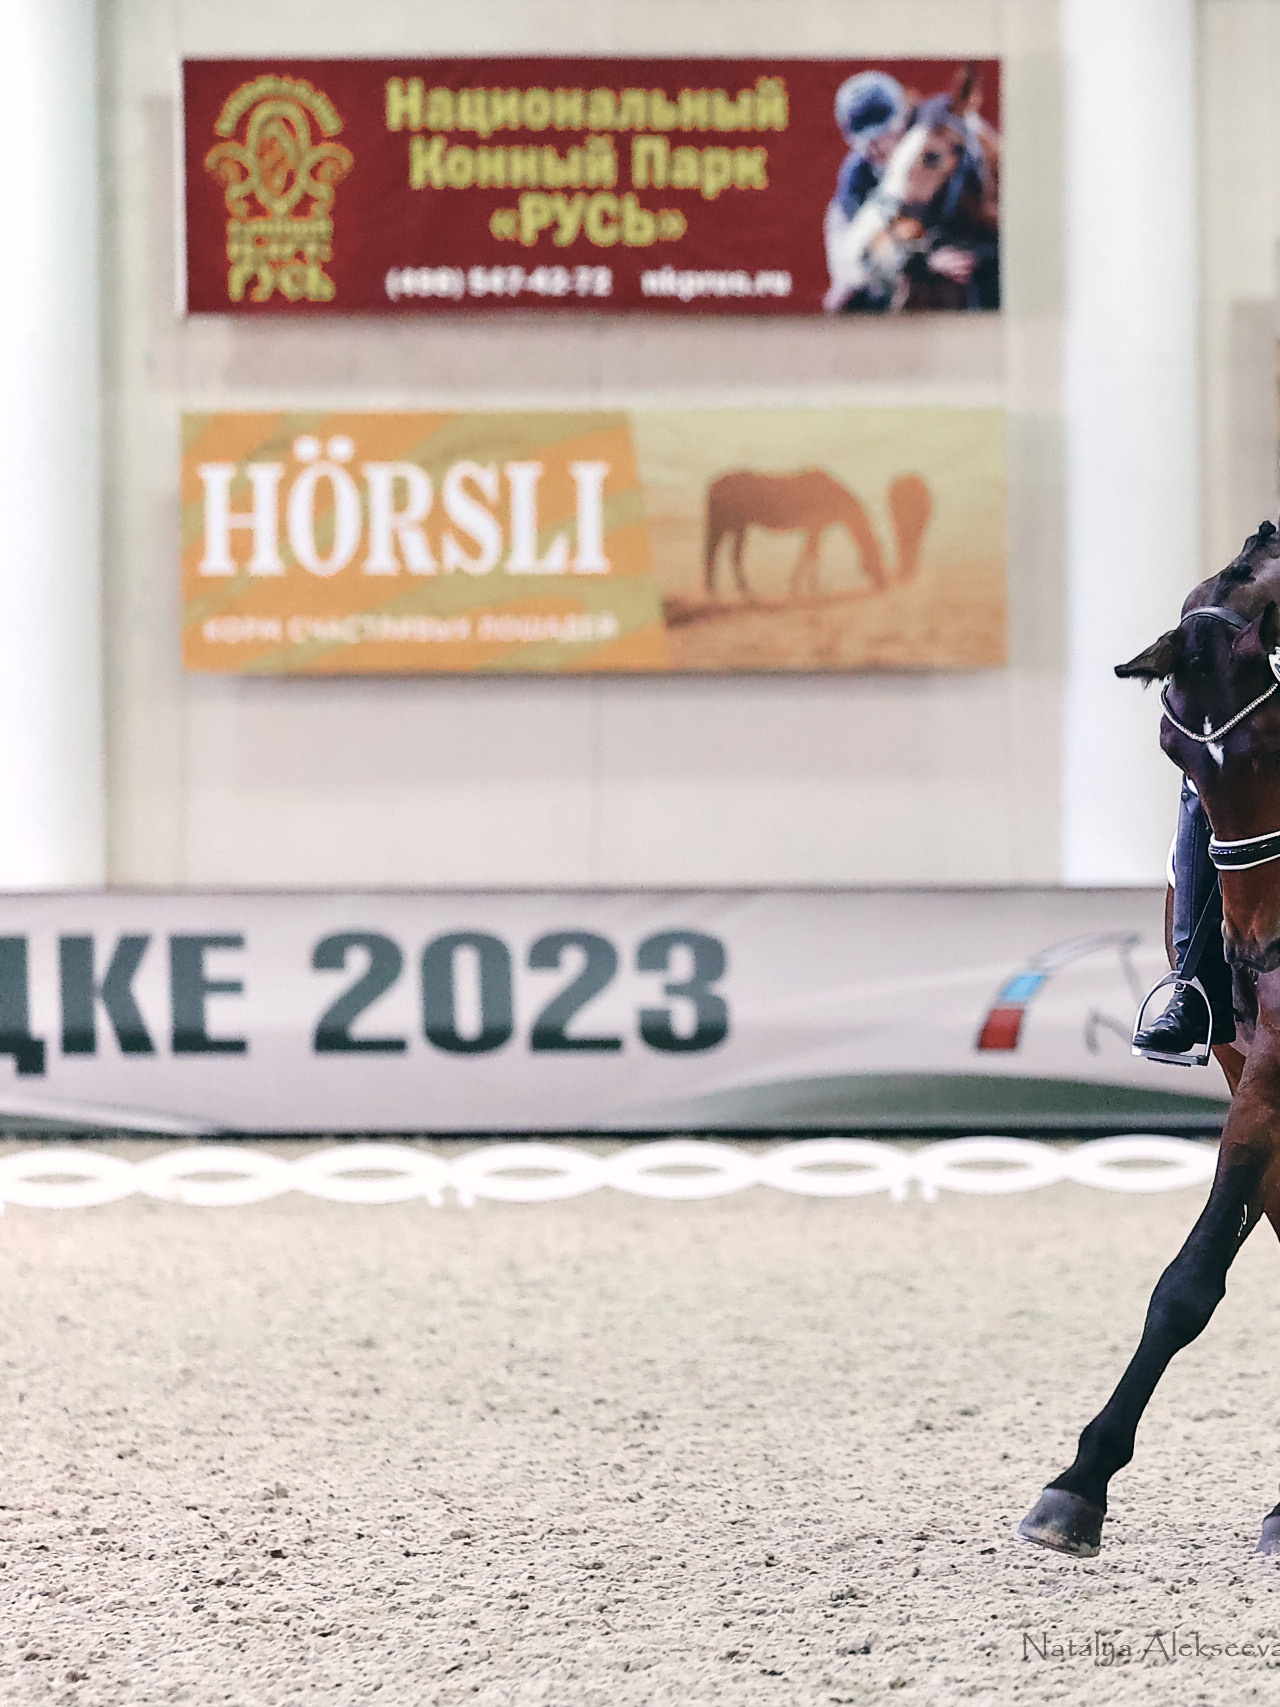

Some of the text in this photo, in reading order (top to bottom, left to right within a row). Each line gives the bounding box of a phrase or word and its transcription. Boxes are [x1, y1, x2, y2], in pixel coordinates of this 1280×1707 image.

[386, 76, 790, 136] Национальный
[409, 136, 768, 198] Конный Парк
[490, 193, 688, 247] «РУСЬ»
[199, 436, 611, 577] HÖRSLI
[311, 929, 730, 1056] 2023
